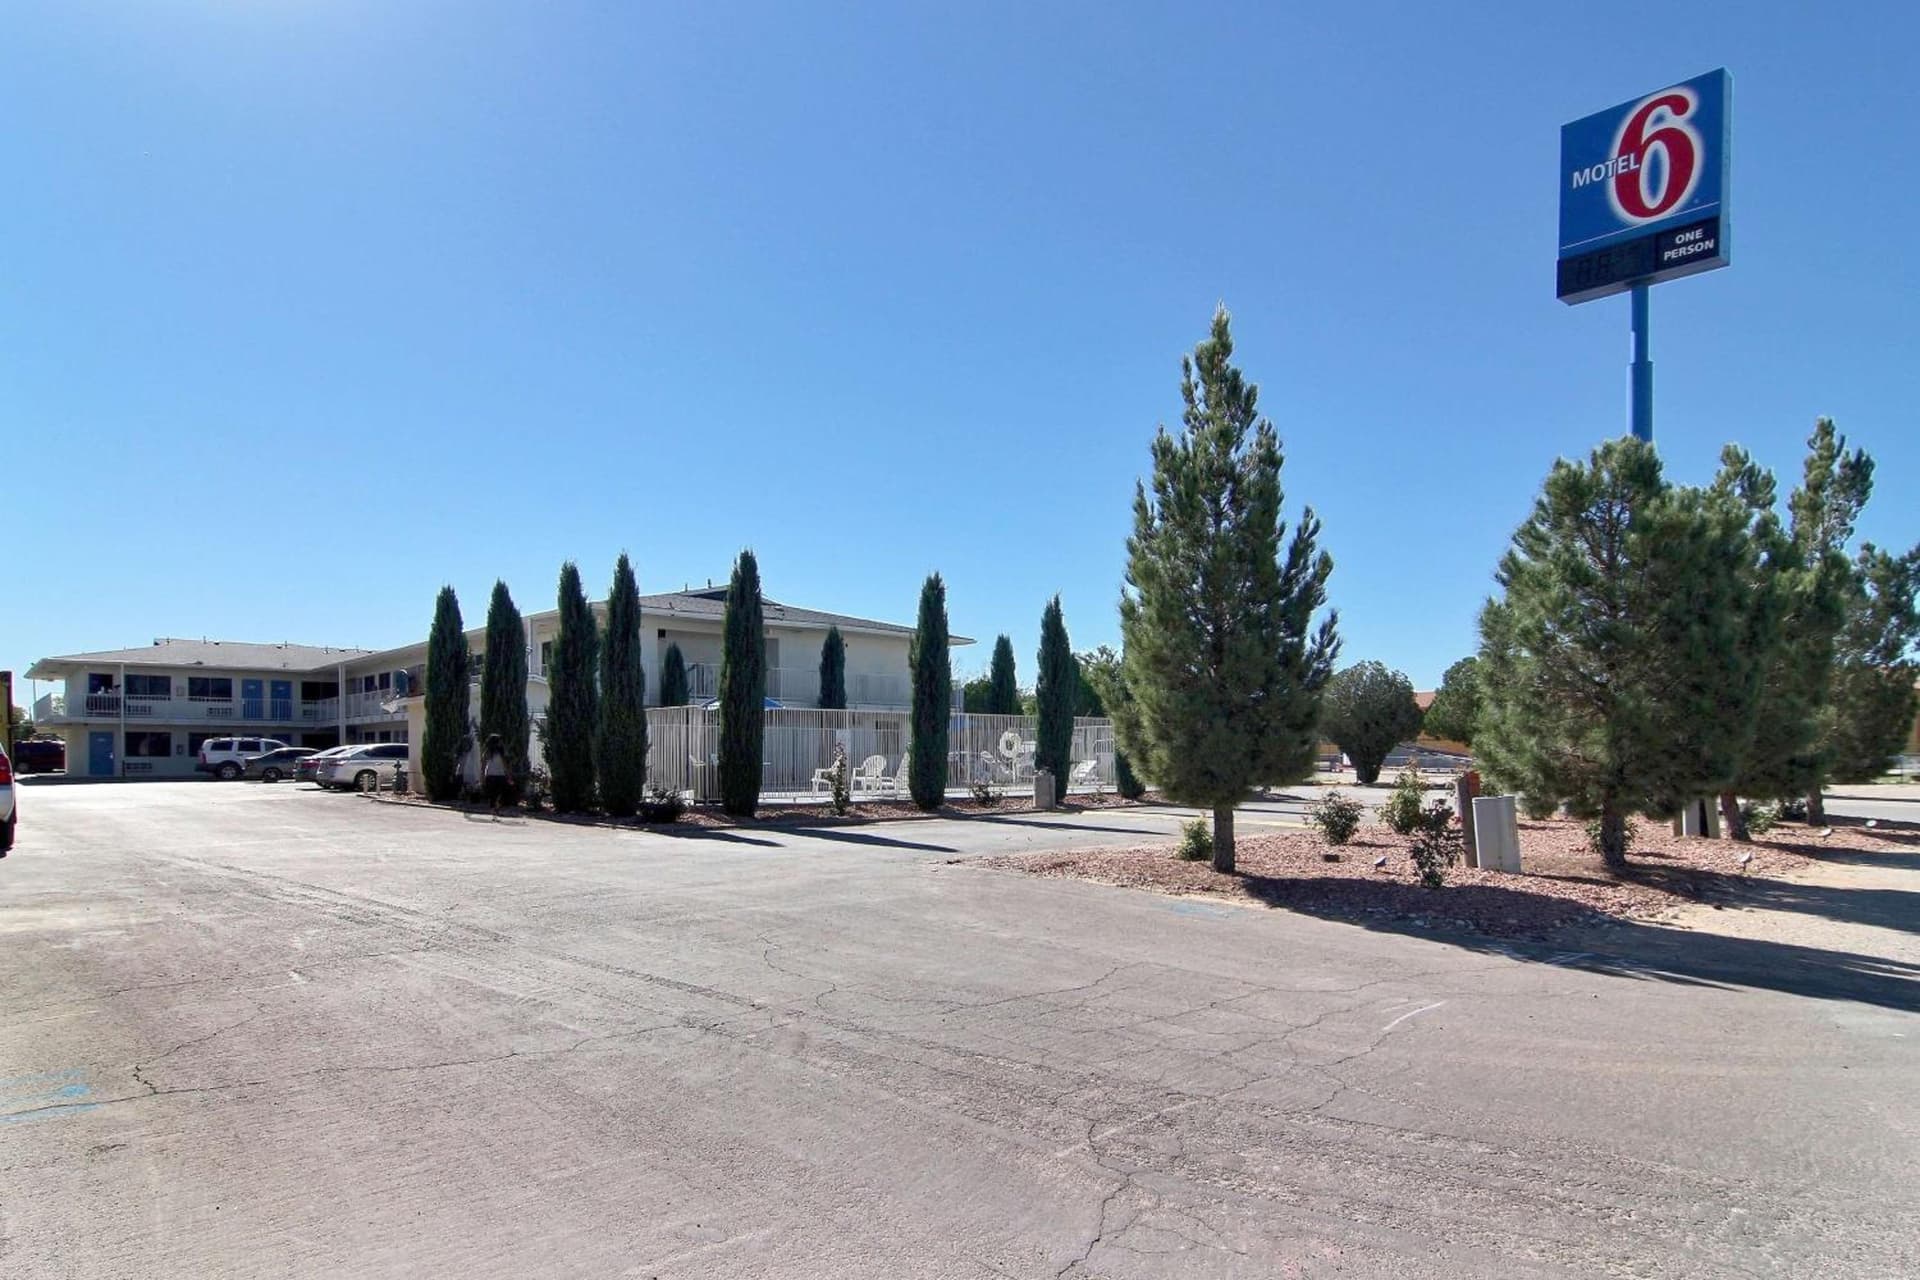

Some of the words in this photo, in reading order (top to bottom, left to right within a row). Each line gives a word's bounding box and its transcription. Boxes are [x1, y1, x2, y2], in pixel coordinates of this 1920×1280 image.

[1572, 153, 1640, 189] MOTEL
[1611, 90, 1699, 222] 6
[1675, 228, 1704, 245] ONE
[1663, 238, 1715, 261] PERSON
